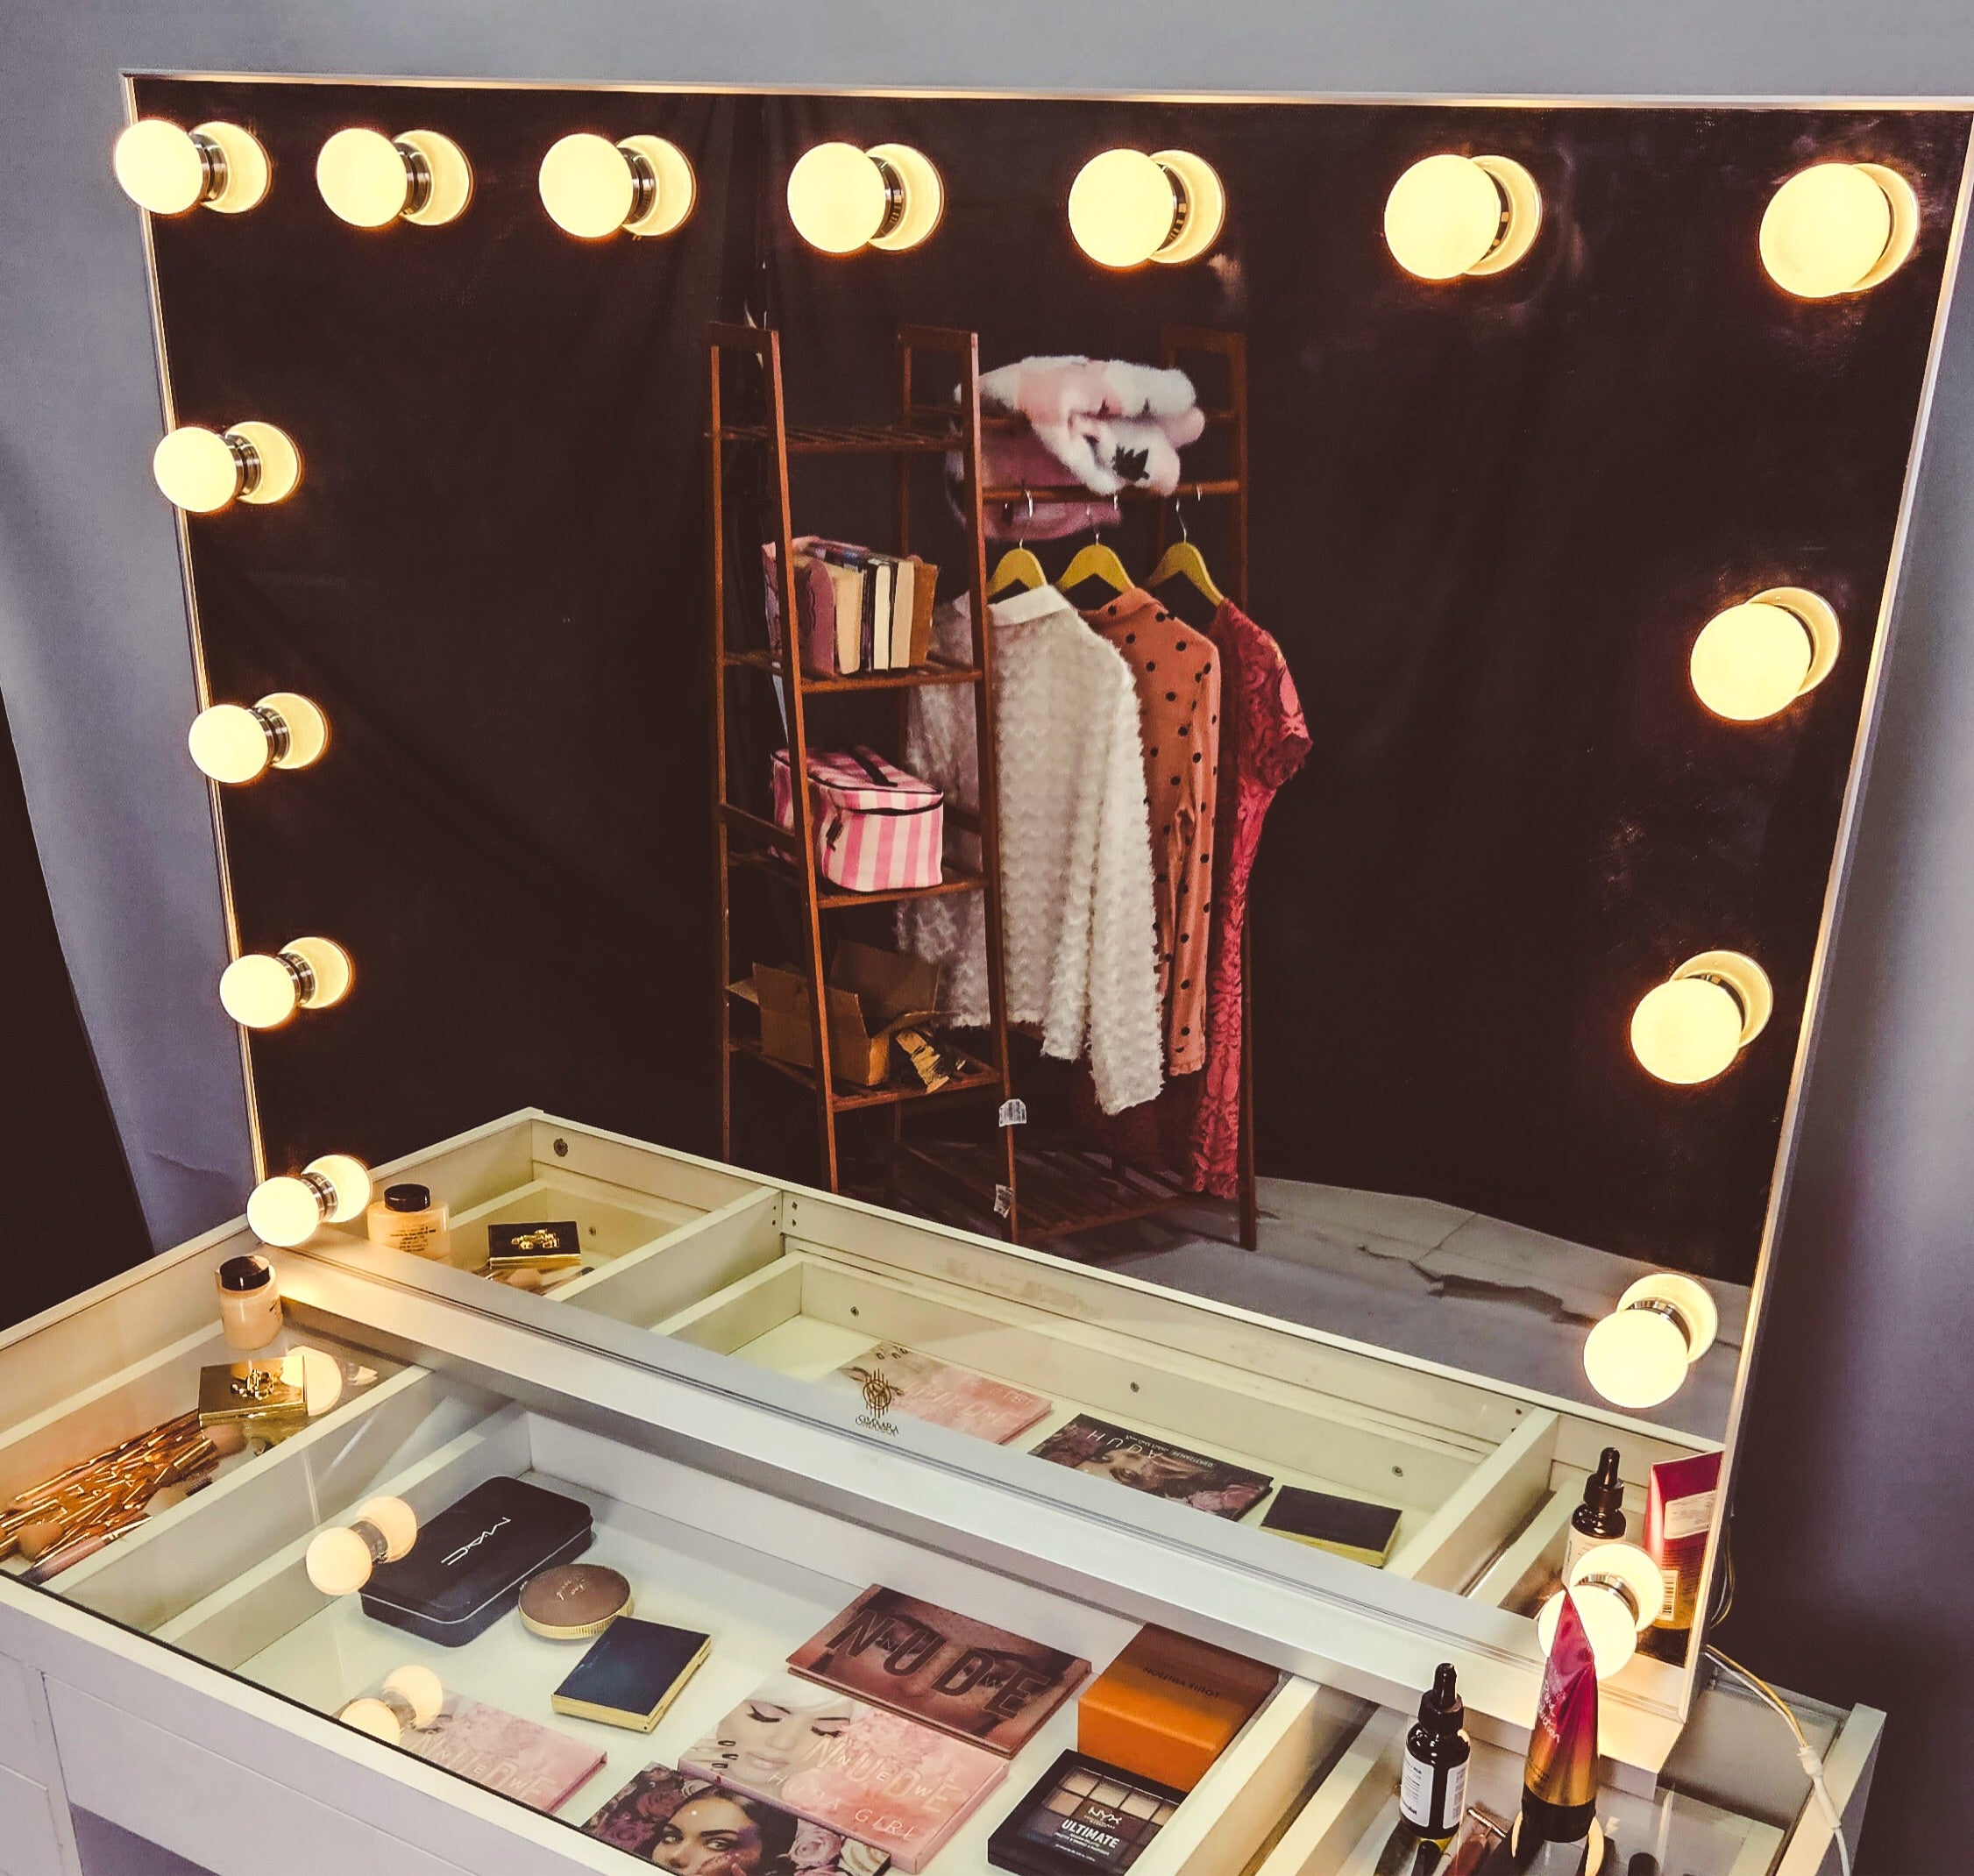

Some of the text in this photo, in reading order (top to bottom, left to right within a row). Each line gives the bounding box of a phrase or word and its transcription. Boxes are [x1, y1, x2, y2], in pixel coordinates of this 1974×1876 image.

[827, 1608, 1051, 1719] NUDE
[801, 1734, 962, 1813] NUDE
[855, 1808, 919, 1842] GIRL
[1087, 1806, 1122, 1824] NYX
[1061, 1818, 1120, 1849] ULTIMATE
